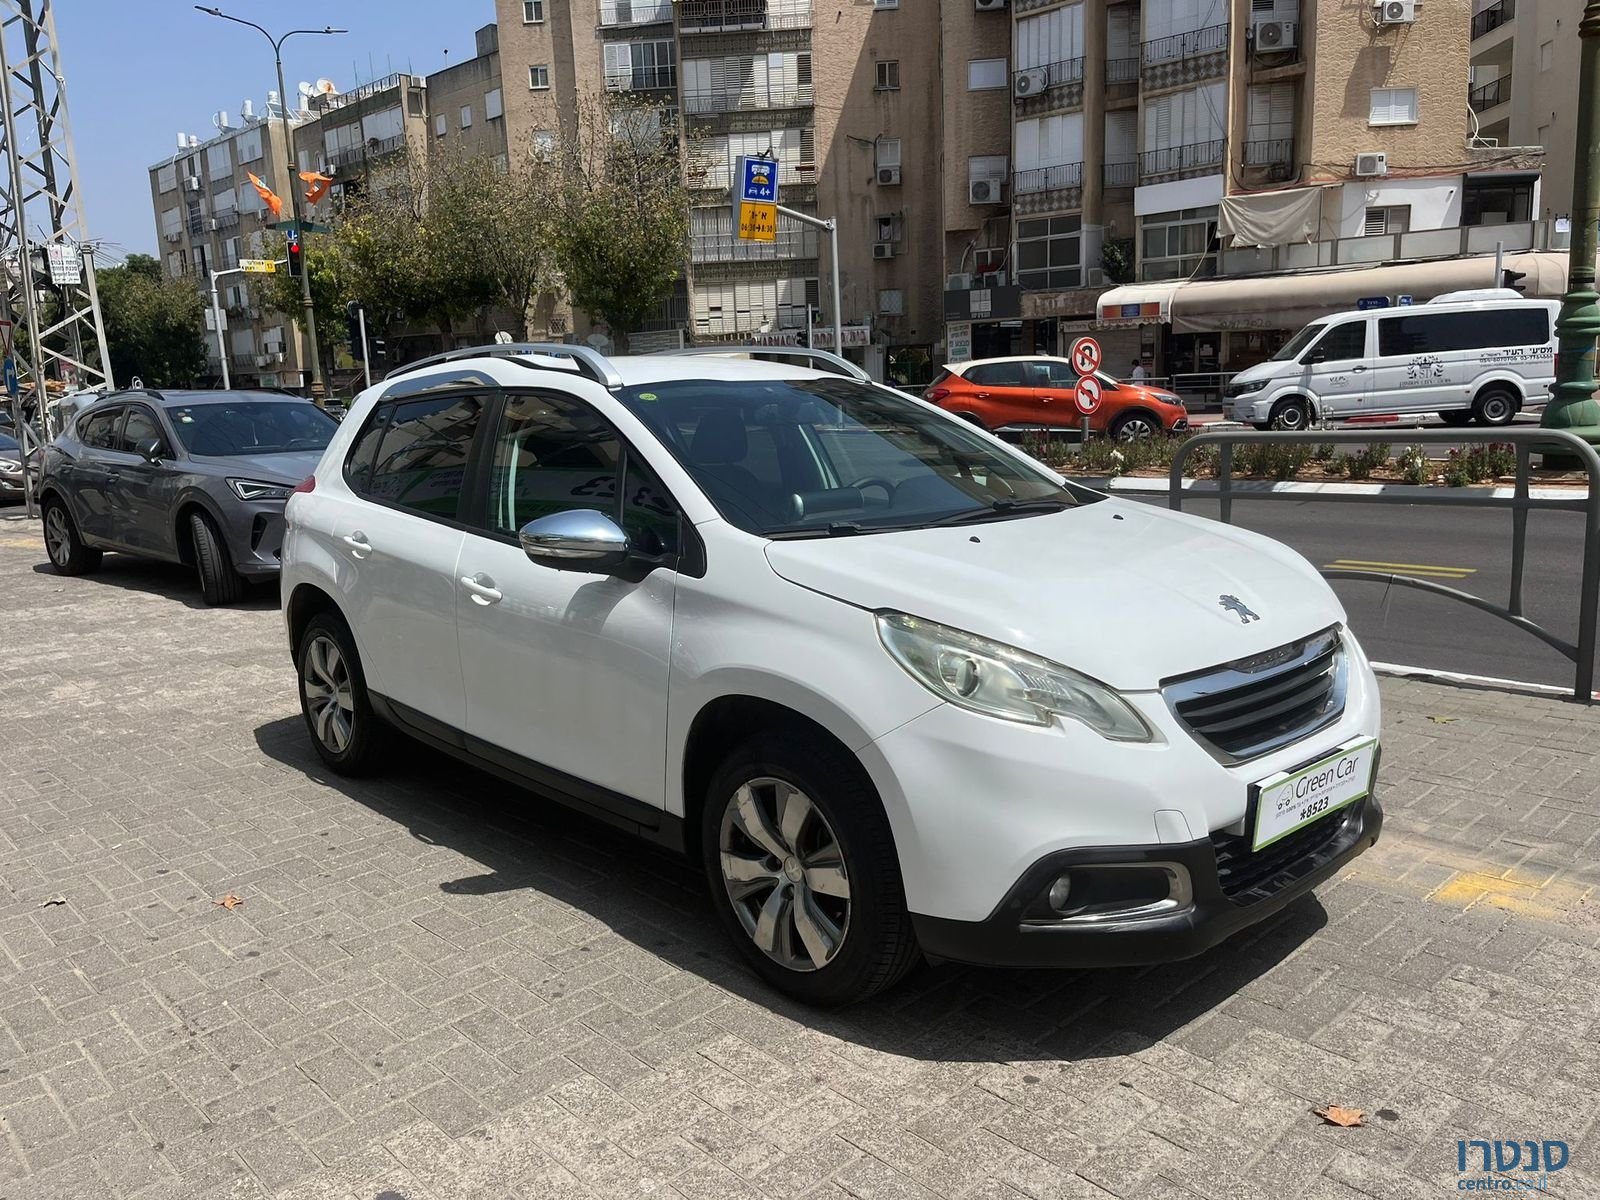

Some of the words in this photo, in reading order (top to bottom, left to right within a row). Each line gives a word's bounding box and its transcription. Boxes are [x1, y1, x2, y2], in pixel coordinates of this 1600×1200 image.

[760, 187, 771, 196] 4+
[1295, 767, 1334, 799] Green
[1336, 757, 1359, 779] Car
